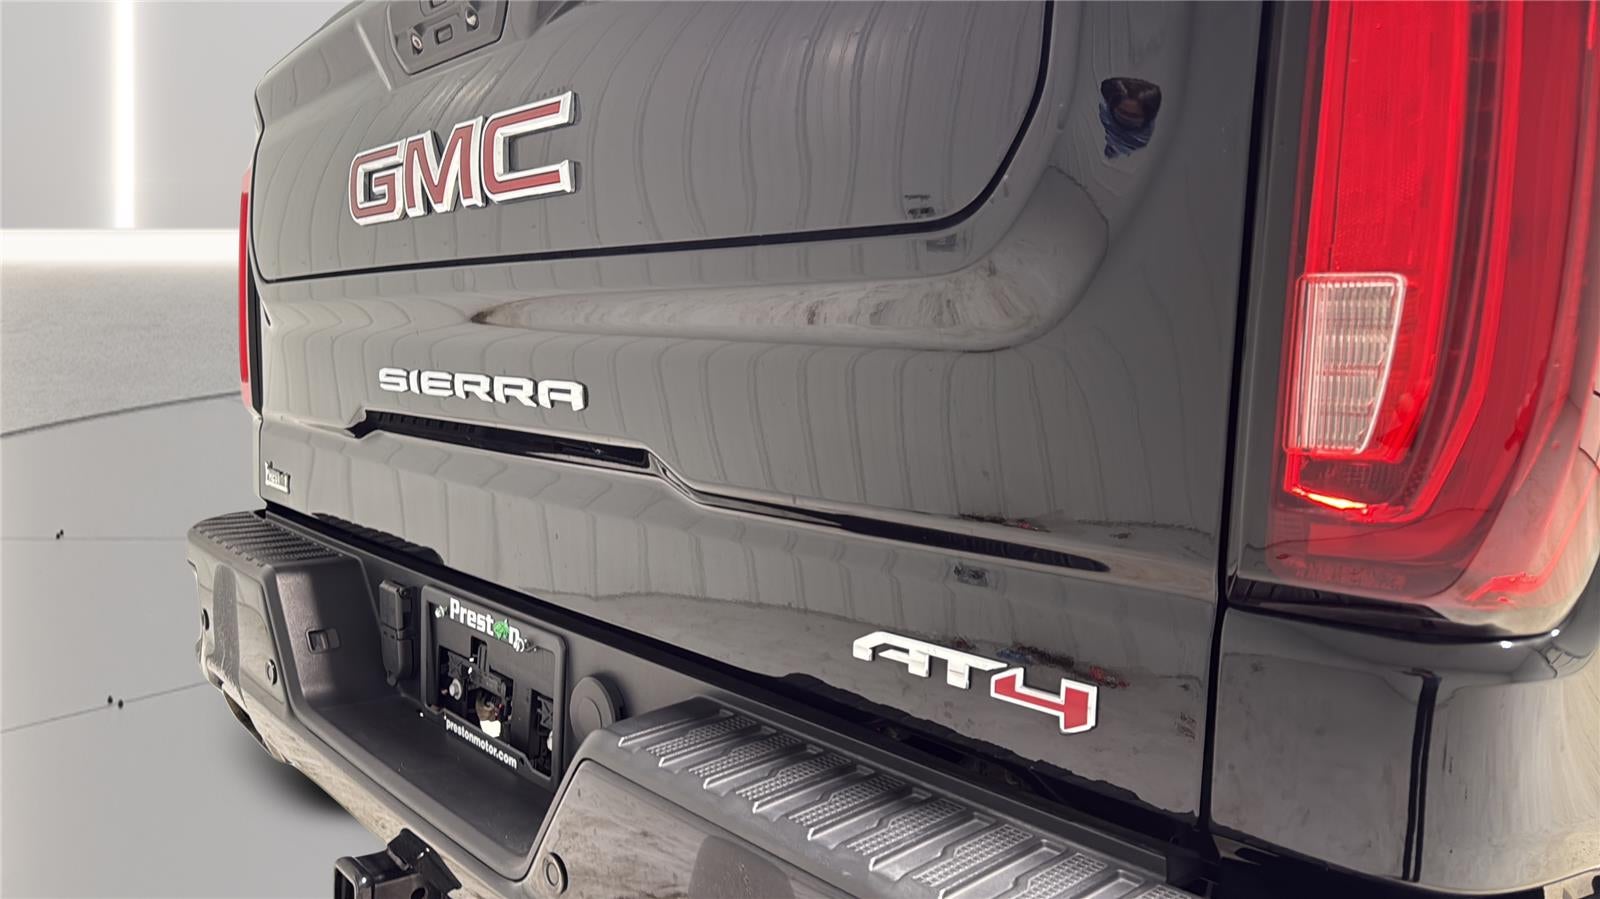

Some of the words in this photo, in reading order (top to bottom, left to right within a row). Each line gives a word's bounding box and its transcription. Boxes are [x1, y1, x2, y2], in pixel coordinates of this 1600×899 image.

[349, 90, 577, 226] GMC
[378, 367, 588, 411] SIERRA
[852, 630, 1098, 734] AT4
[446, 719, 518, 769] prestonmotor.com
